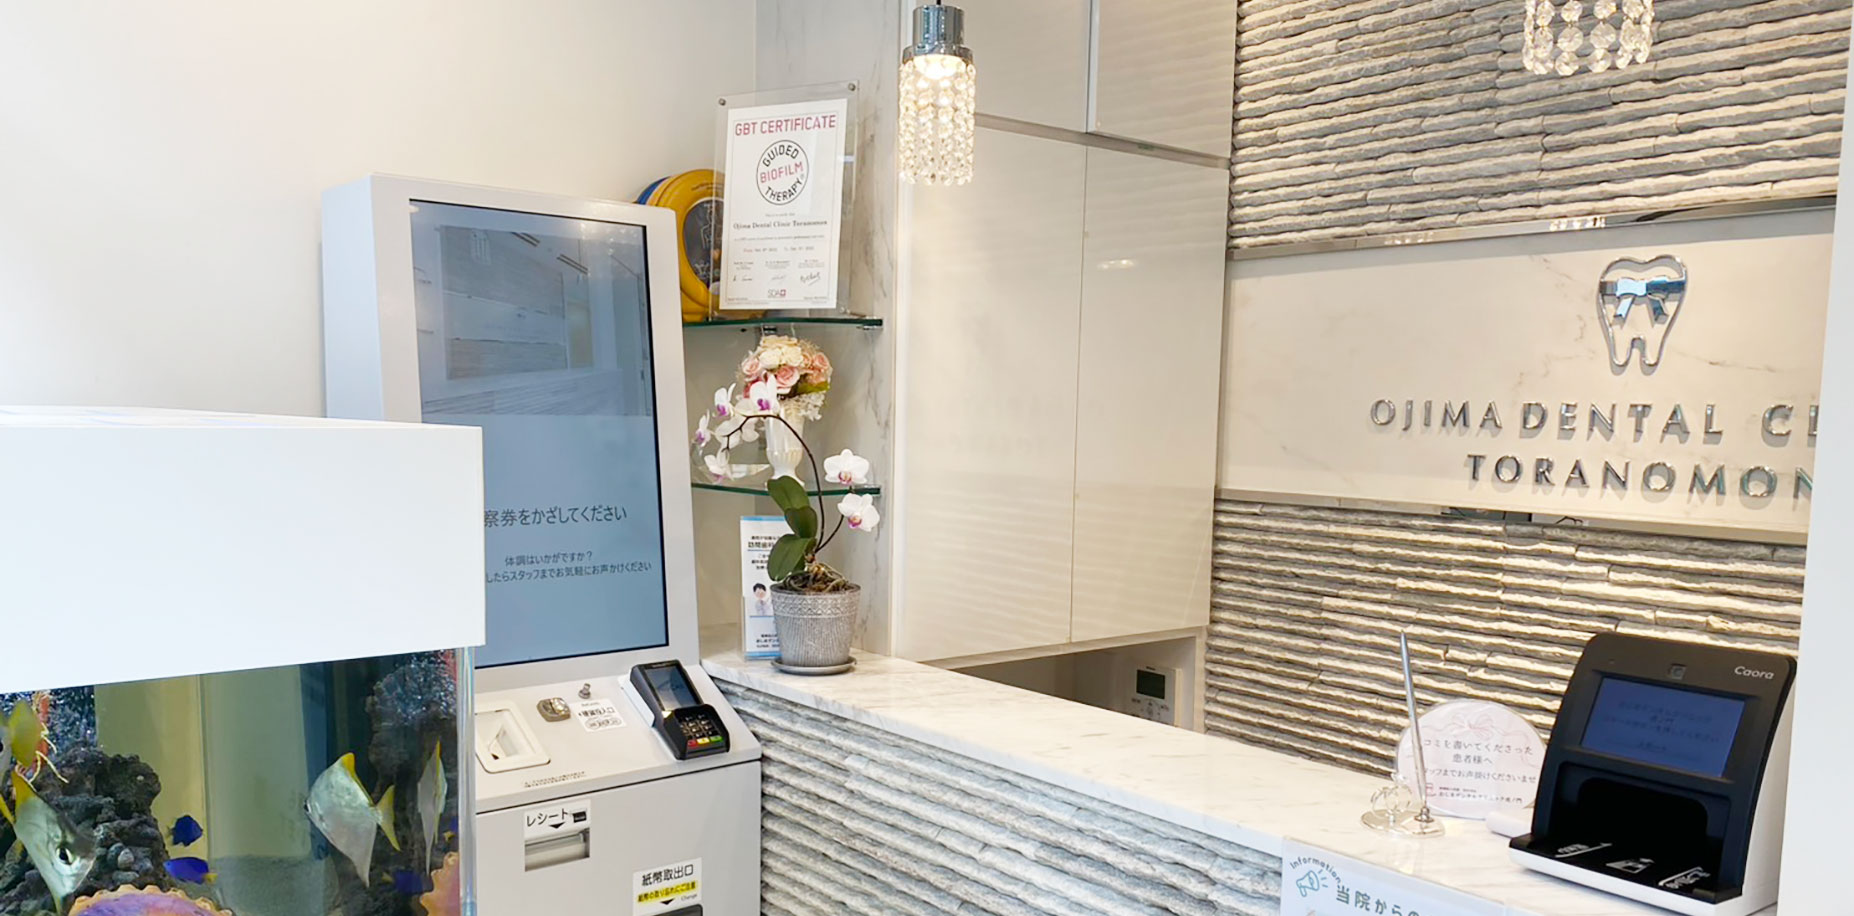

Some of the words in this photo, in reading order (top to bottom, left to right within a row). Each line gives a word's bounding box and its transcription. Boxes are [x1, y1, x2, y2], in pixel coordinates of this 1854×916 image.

[735, 122, 757, 136] GBT
[760, 115, 836, 134] CERTIFICATE
[763, 145, 799, 167] GUIDED
[760, 161, 803, 183] BIOFILM
[765, 178, 802, 202] THERAPY
[1371, 400, 1502, 431] OJIMA
[1522, 402, 1723, 434] DENTAL
[1467, 454, 1812, 498] TORANOMON
[1734, 665, 1775, 680] Caora
[527, 808, 568, 827] レシート
[642, 864, 693, 887] 紙幣取出口
[1290, 857, 1342, 884] Information
